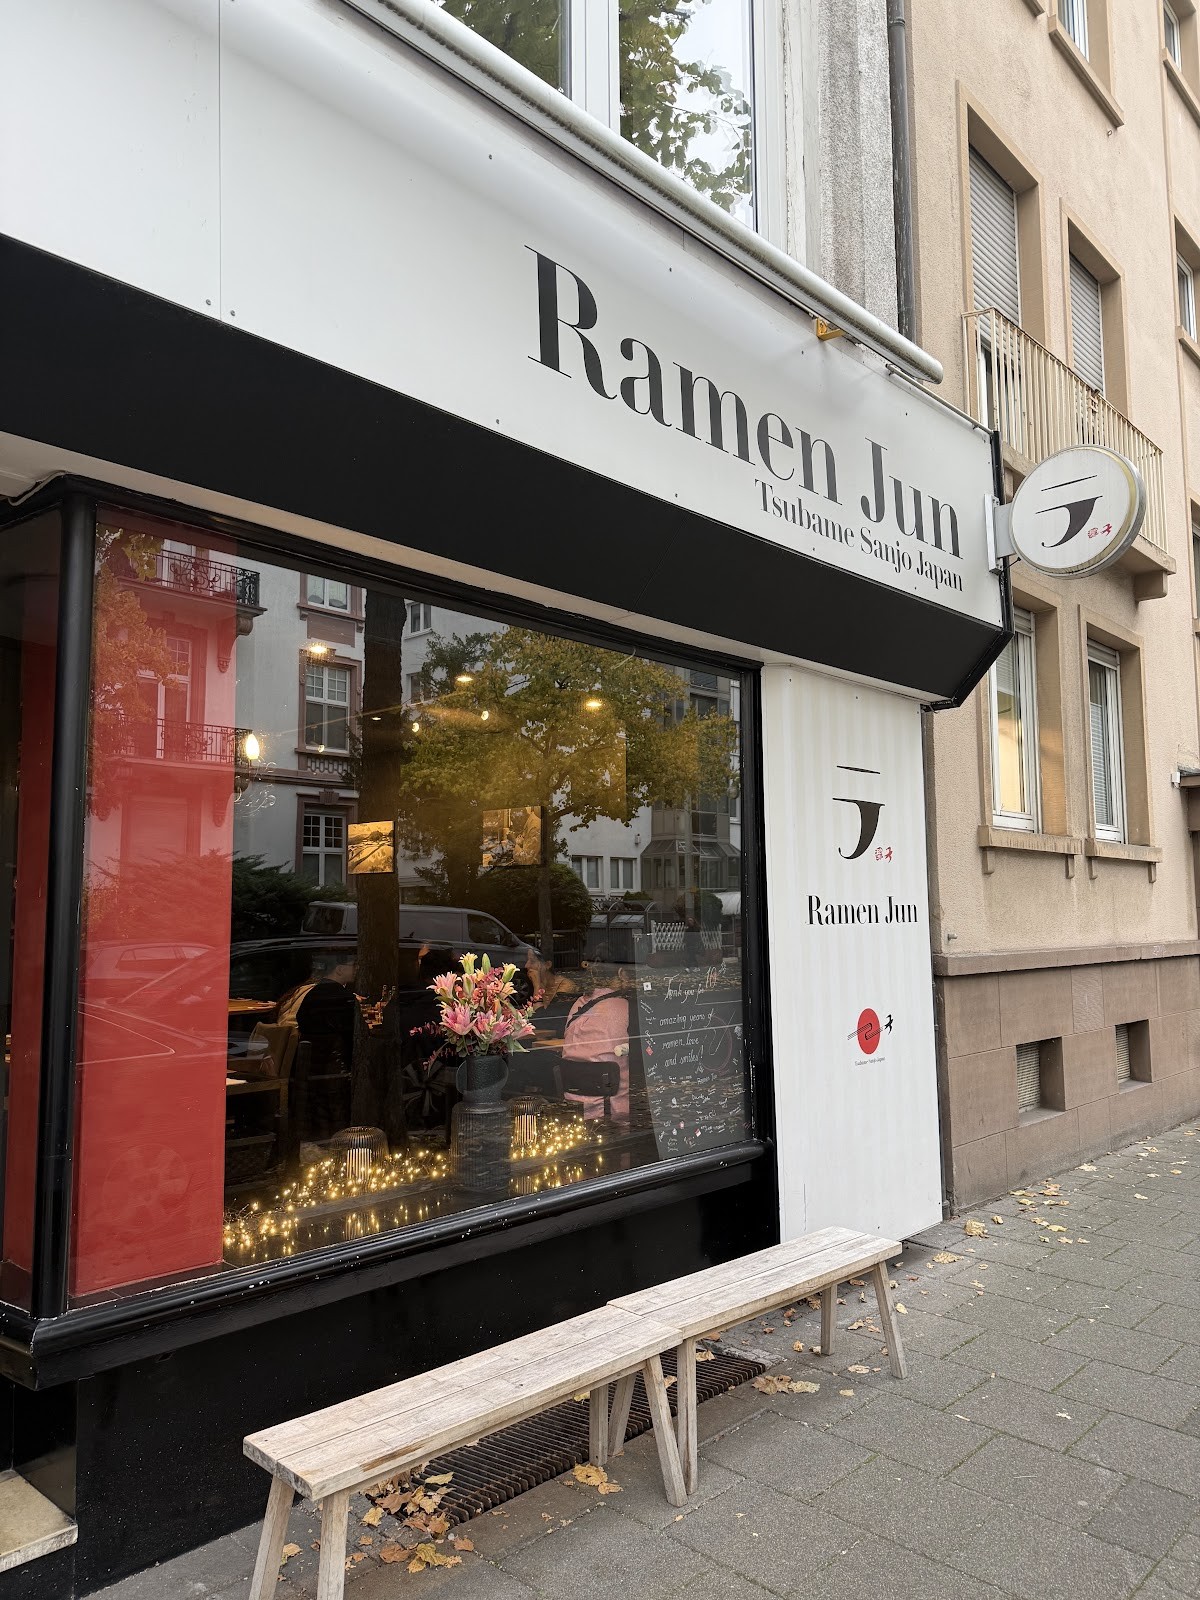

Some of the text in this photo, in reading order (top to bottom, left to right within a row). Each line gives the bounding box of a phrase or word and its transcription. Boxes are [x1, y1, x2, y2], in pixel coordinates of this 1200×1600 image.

[524, 244, 964, 560] Ramen Jun
[754, 478, 964, 592] Tsubame Sanjo Japan
[807, 894, 919, 926] Ramen Jun
[659, 1012, 687, 1030] amazing
[686, 1032, 700, 1046] love
